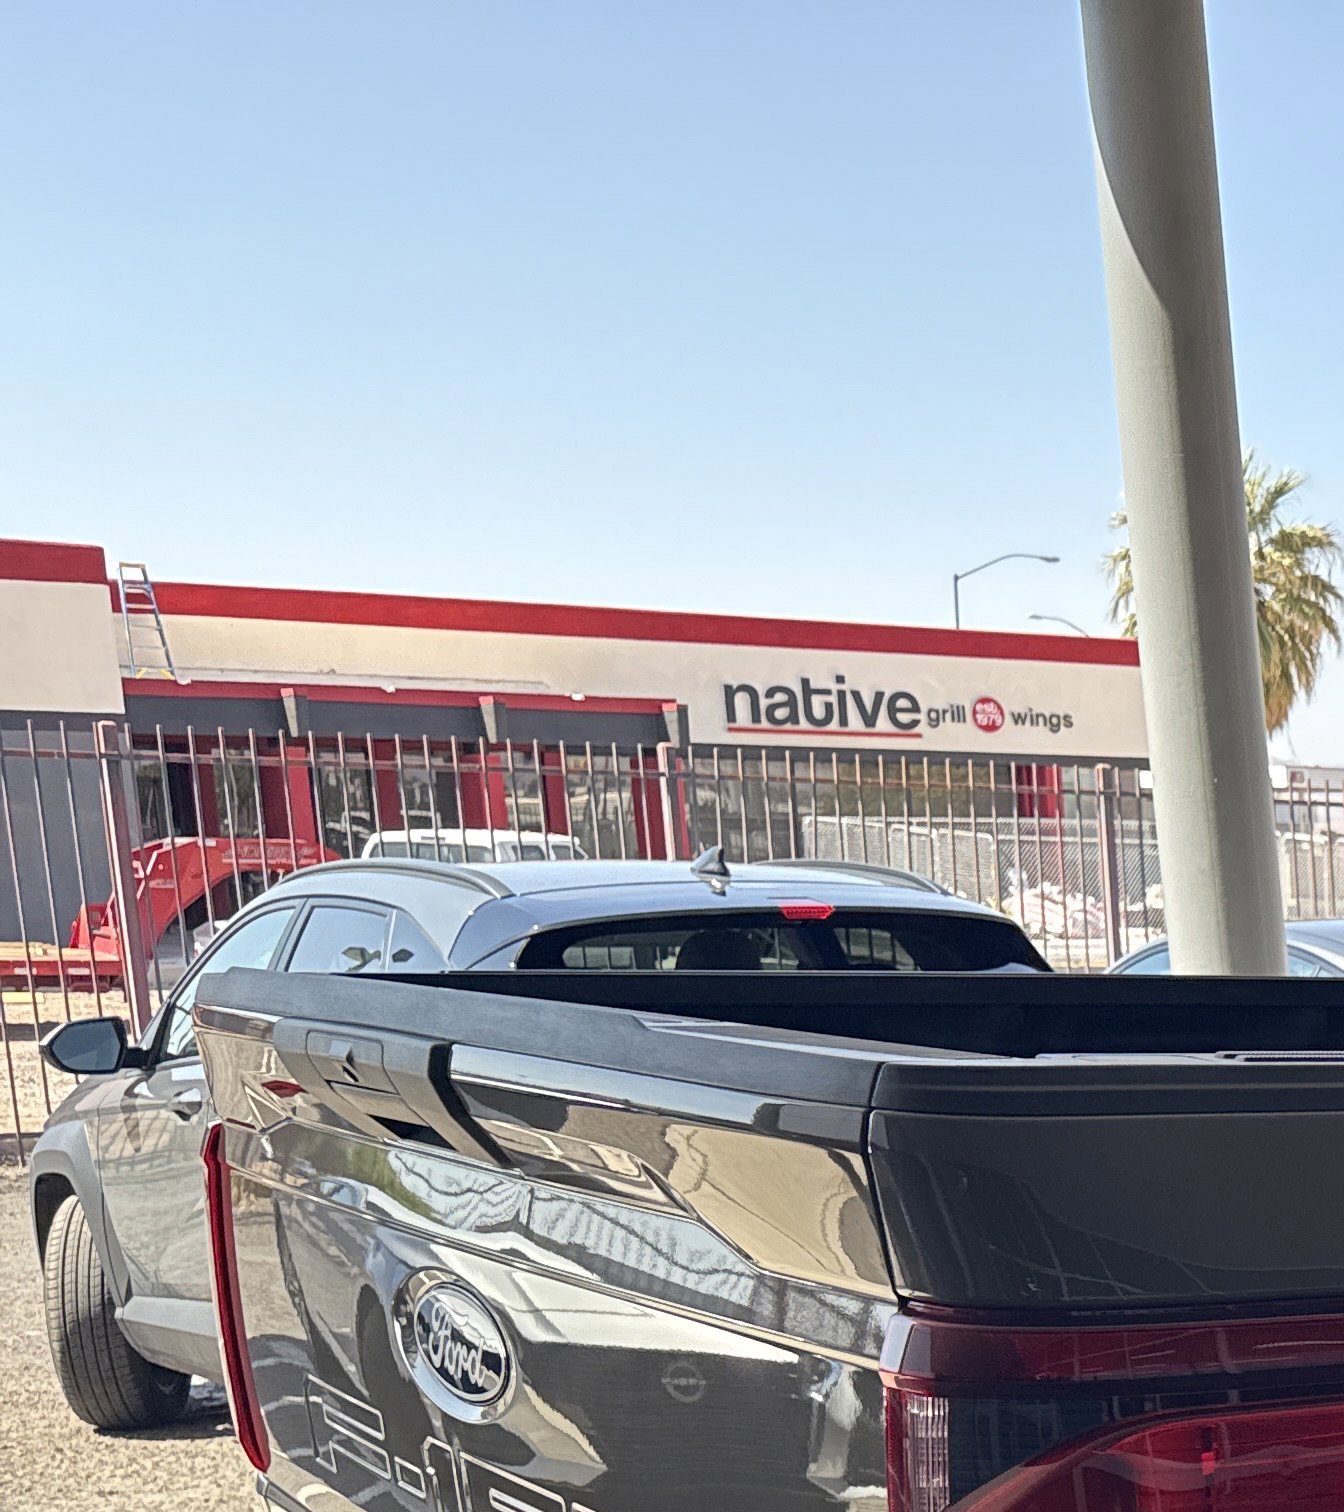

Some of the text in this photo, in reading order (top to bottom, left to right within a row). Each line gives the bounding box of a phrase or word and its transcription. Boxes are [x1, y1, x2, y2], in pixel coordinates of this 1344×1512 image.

[723, 674, 1075, 734] native grill wings
[425, 1299, 502, 1390] Ford
